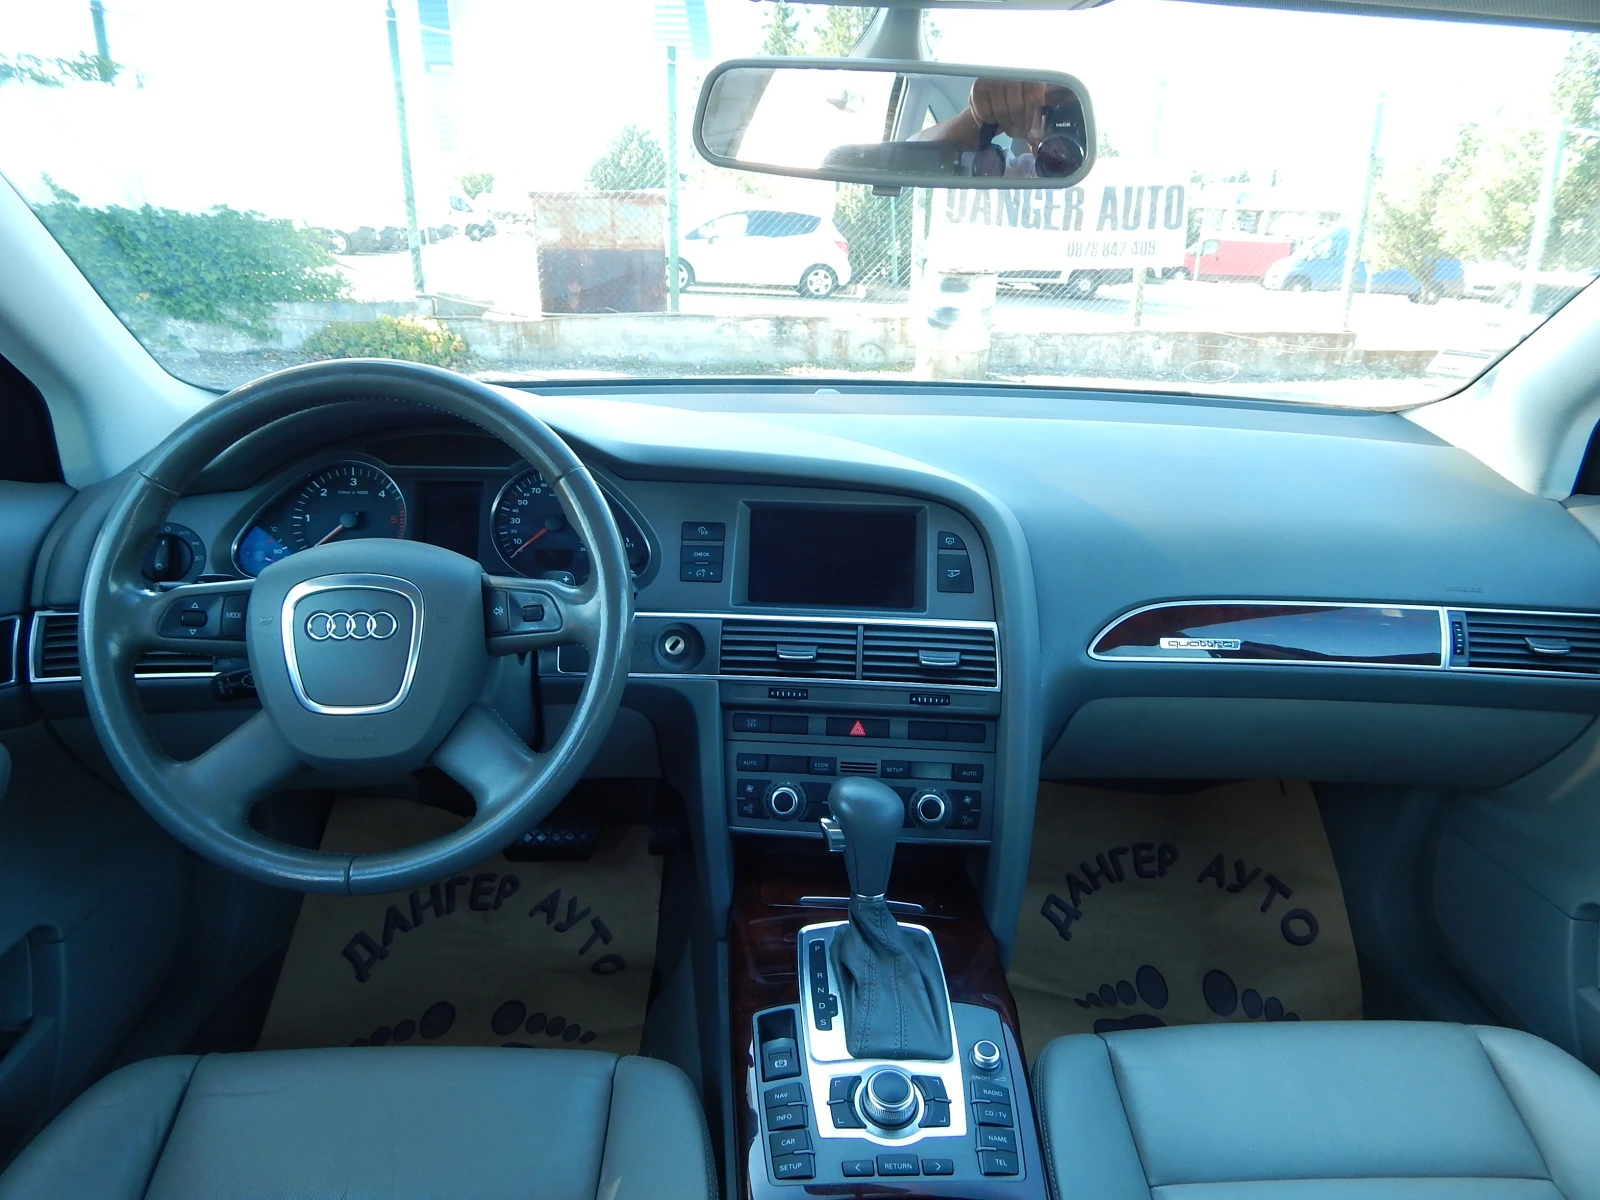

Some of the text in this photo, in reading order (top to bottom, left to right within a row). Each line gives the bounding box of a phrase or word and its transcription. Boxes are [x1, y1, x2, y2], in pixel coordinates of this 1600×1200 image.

[1096, 185, 1185, 232] AUTO
[1102, 241, 1127, 258] 842
[1131, 240, 1156, 256] 409
[350, 477, 358, 486] 3
[320, 488, 328, 497] 2
[378, 490, 386, 498] 4
[305, 514, 310, 522] 1
[226, 611, 242, 619] MODE
[1040, 842, 1320, 947] ДАНГЕР АУТО
[341, 872, 627, 984] ДАНГЕР АУТО
[820, 1018, 827, 1026] S
[983, 1089, 1003, 1097] RADIO
[776, 1113, 792, 1122] INFO
[781, 1138, 796, 1146] CAR
[988, 1135, 1008, 1143] NAME
[884, 1162, 913, 1170] RETURN
[995, 1158, 1008, 1166] TEL
[779, 1162, 802, 1171] SETUP
